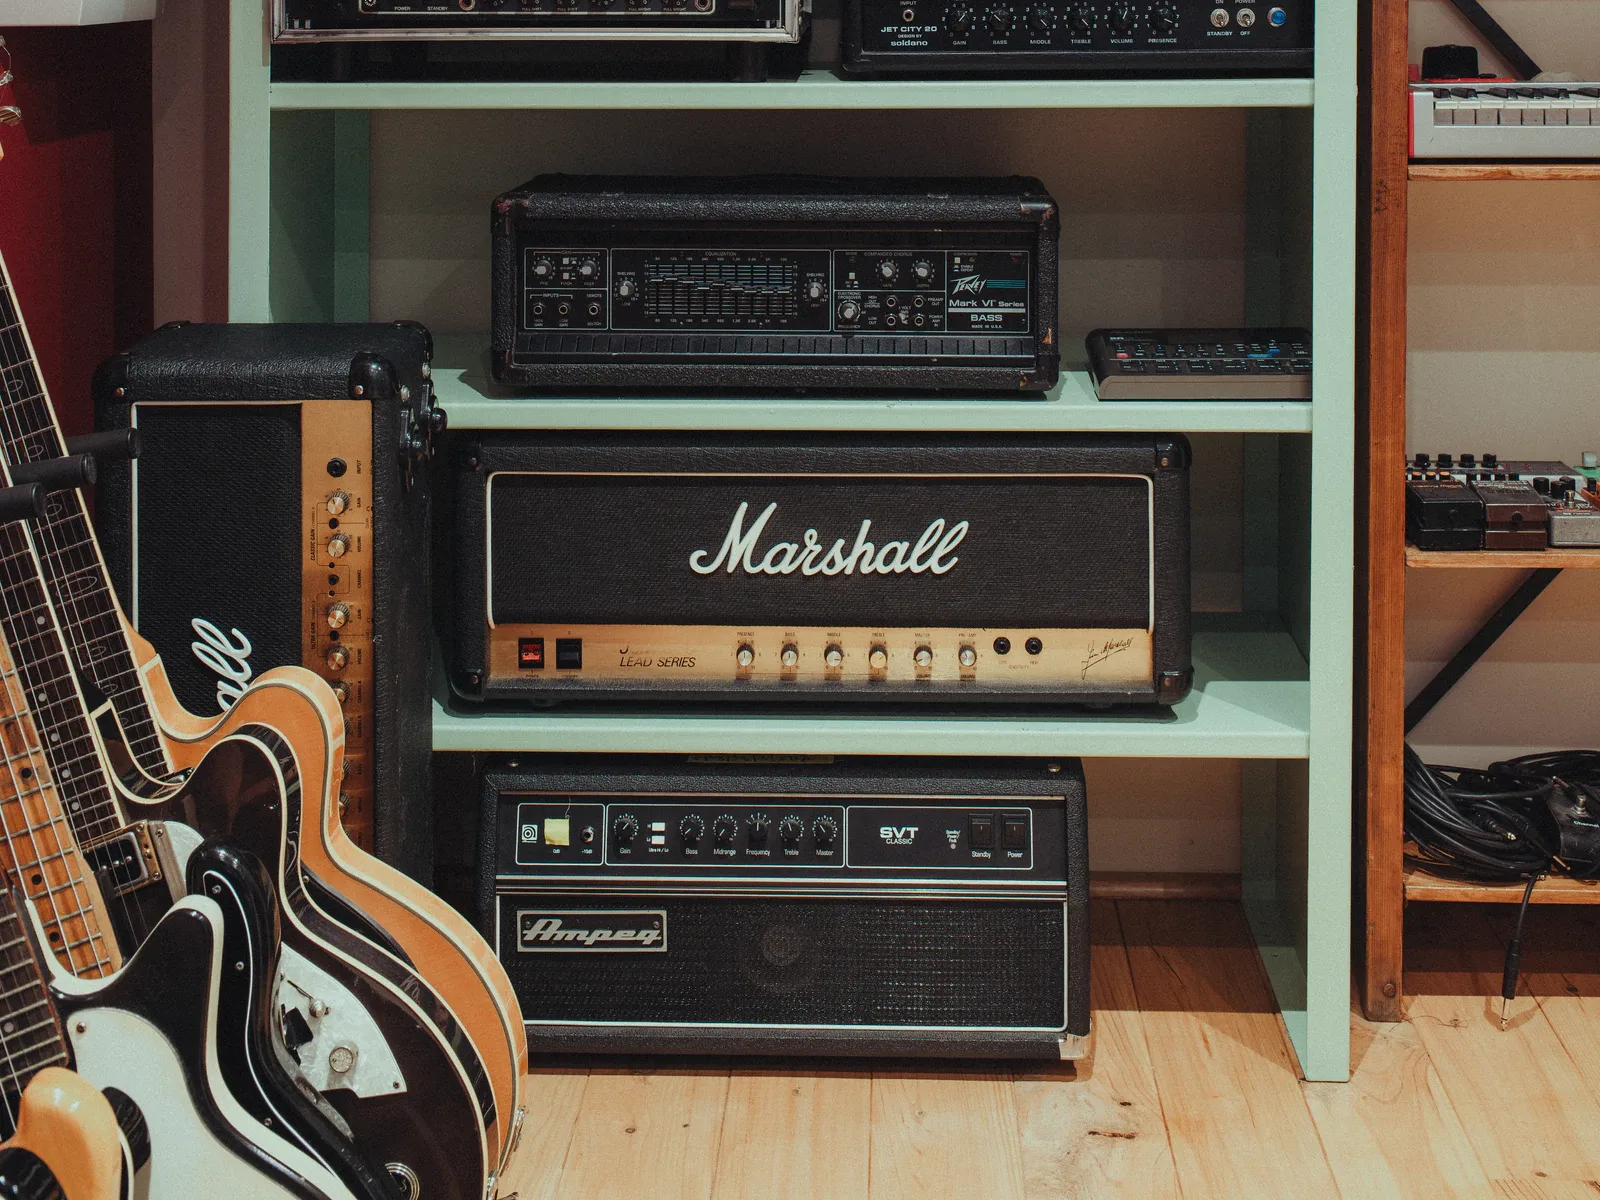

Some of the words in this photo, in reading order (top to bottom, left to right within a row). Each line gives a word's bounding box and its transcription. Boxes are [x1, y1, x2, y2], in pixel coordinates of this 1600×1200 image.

[689, 501, 969, 575] Marshall
[620, 657, 652, 667] LEAD
[657, 657, 696, 668] SERIES
[879, 827, 919, 839] SVT
[713, 848, 736, 856] Midrange
[972, 851, 991, 859] Standby
[522, 918, 662, 946] Ampeg
